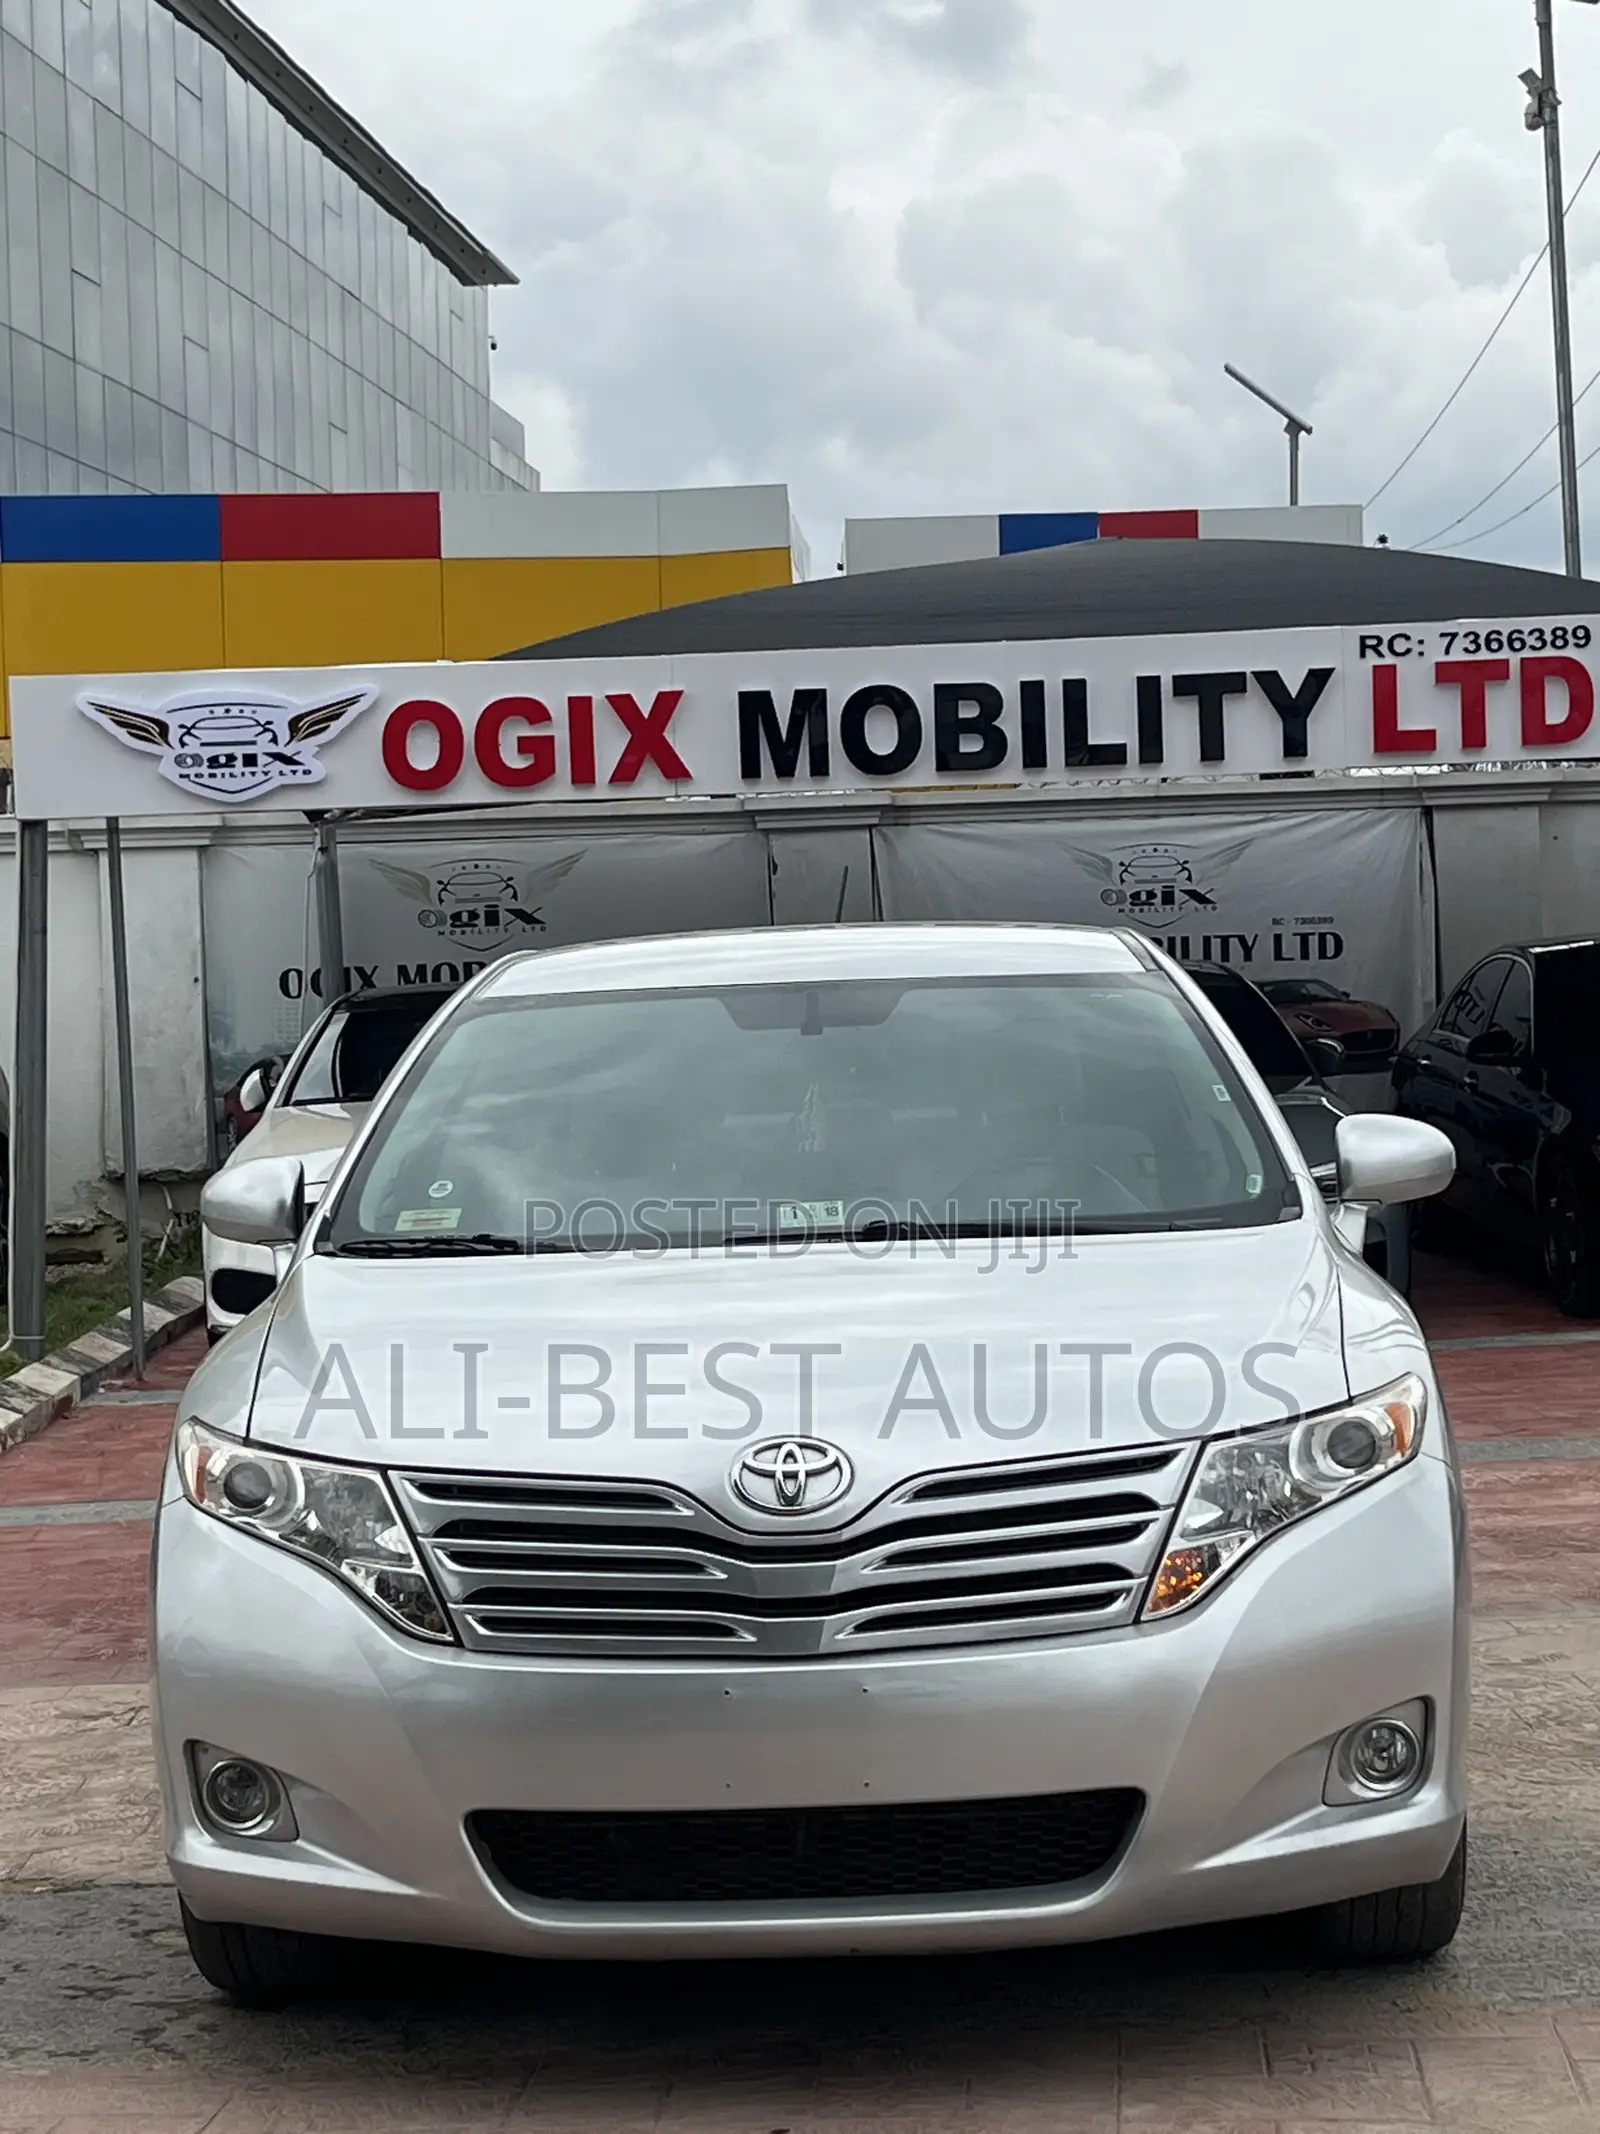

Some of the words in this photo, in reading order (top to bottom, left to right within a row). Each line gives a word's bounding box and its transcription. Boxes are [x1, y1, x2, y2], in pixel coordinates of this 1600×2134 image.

[1359, 633, 1425, 659] RC:
[1439, 625, 1592, 656] 7366389
[382, 690, 693, 791] OGIX
[737, 667, 1336, 780] MOBILITY
[1372, 655, 1595, 754] LTD
[1273, 931, 1344, 962] LTD
